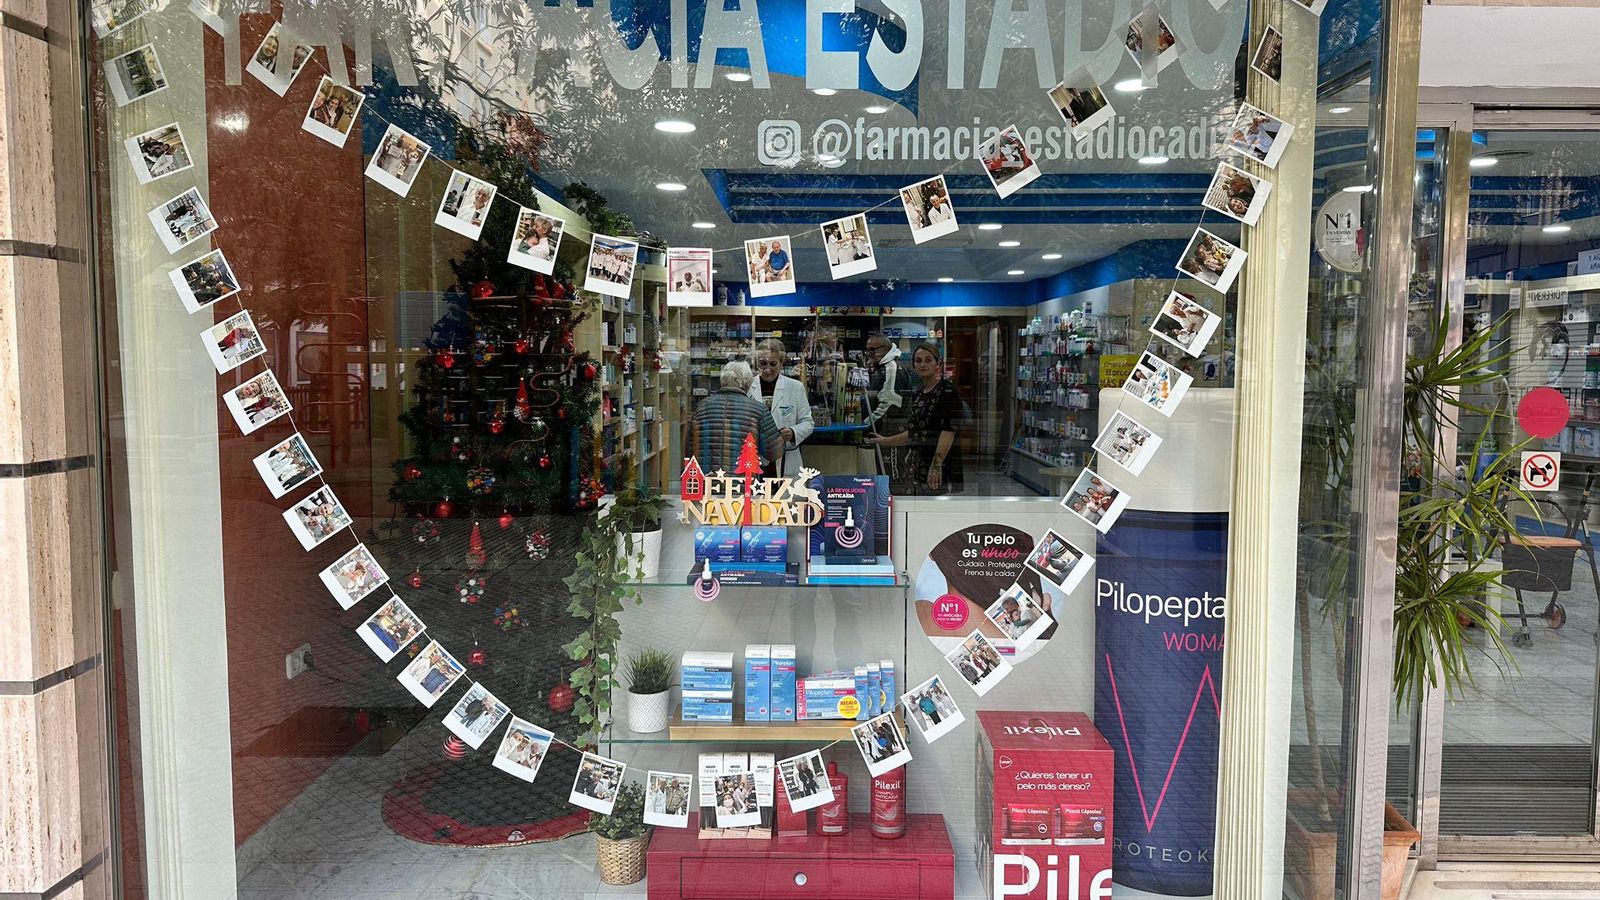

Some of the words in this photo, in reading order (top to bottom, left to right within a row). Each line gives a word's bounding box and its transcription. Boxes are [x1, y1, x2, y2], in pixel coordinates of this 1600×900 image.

[224, 0, 771, 89] FARACIA
[967, 532, 981, 544] Tu
[984, 533, 1015, 546] pelo
[962, 548, 978, 558] es
[981, 545, 1020, 559] único
[1096, 578, 1226, 627] Pilopepta
[1004, 726, 1082, 736] Pilexil
[1015, 771, 1054, 780] ¿Quieres
[875, 780, 901, 790] Pilexil
[1017, 782, 1036, 791] pelo
[1037, 782, 1056, 790] más
[1058, 782, 1091, 790] denso?
